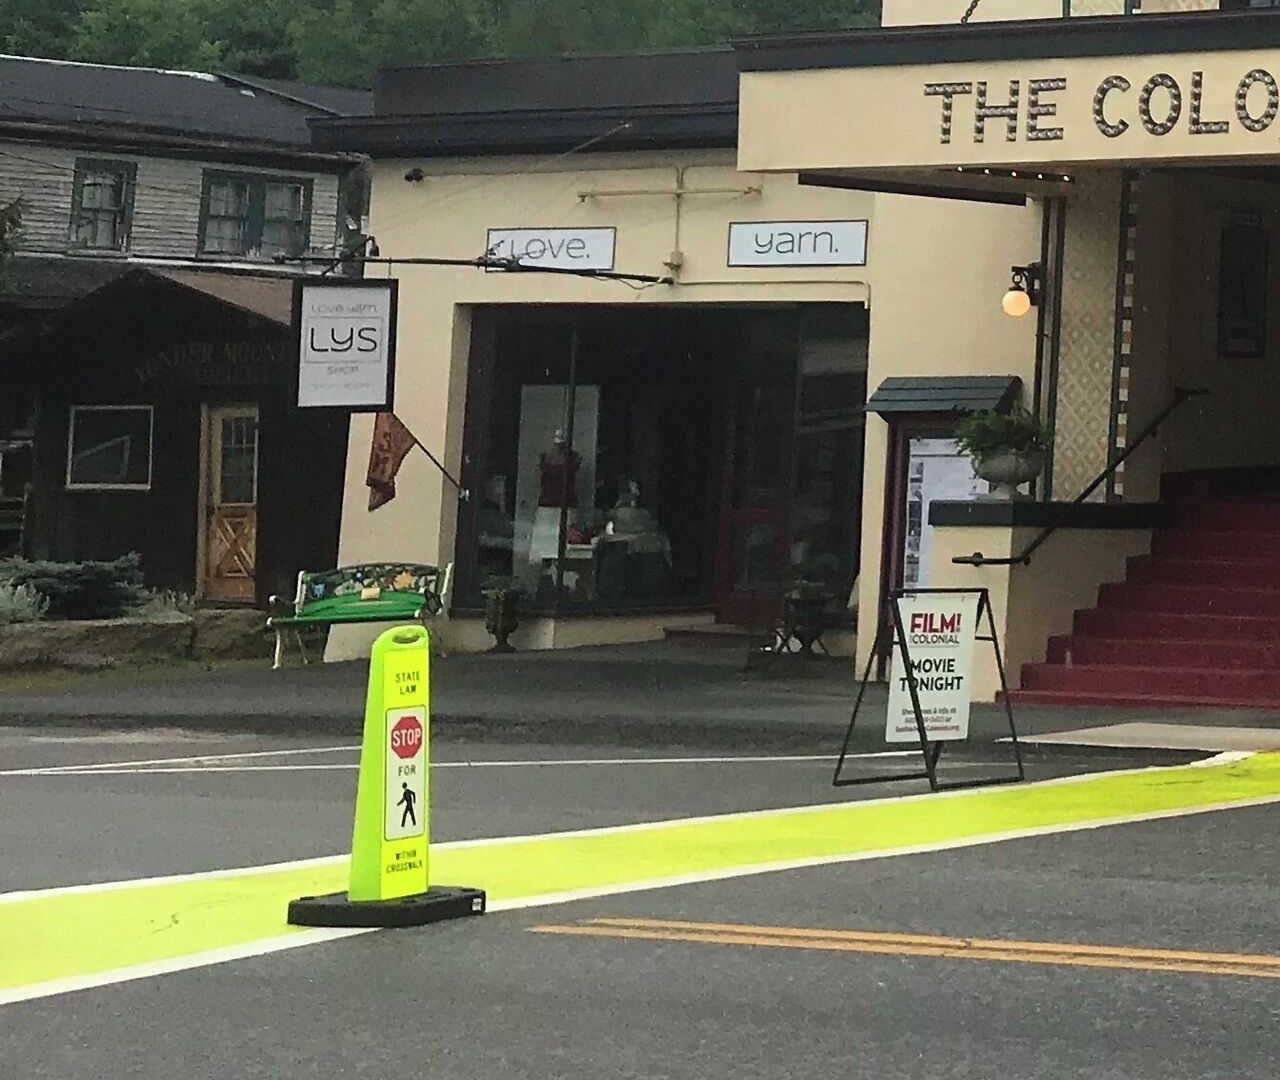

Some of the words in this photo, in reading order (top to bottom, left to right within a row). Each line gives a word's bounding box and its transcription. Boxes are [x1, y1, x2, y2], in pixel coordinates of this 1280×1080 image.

[924, 77, 1067, 144] THE
[754, 230, 839, 255] yarn.
[310, 326, 378, 353] LYS
[910, 613, 962, 633] FILM!
[912, 633, 960, 645] COLONIAL
[910, 658, 956, 673] MOVIE
[395, 670, 421, 683] STATE
[399, 685, 417, 696] LAW
[392, 727, 422, 748] STOP
[397, 764, 417, 777] FOR
